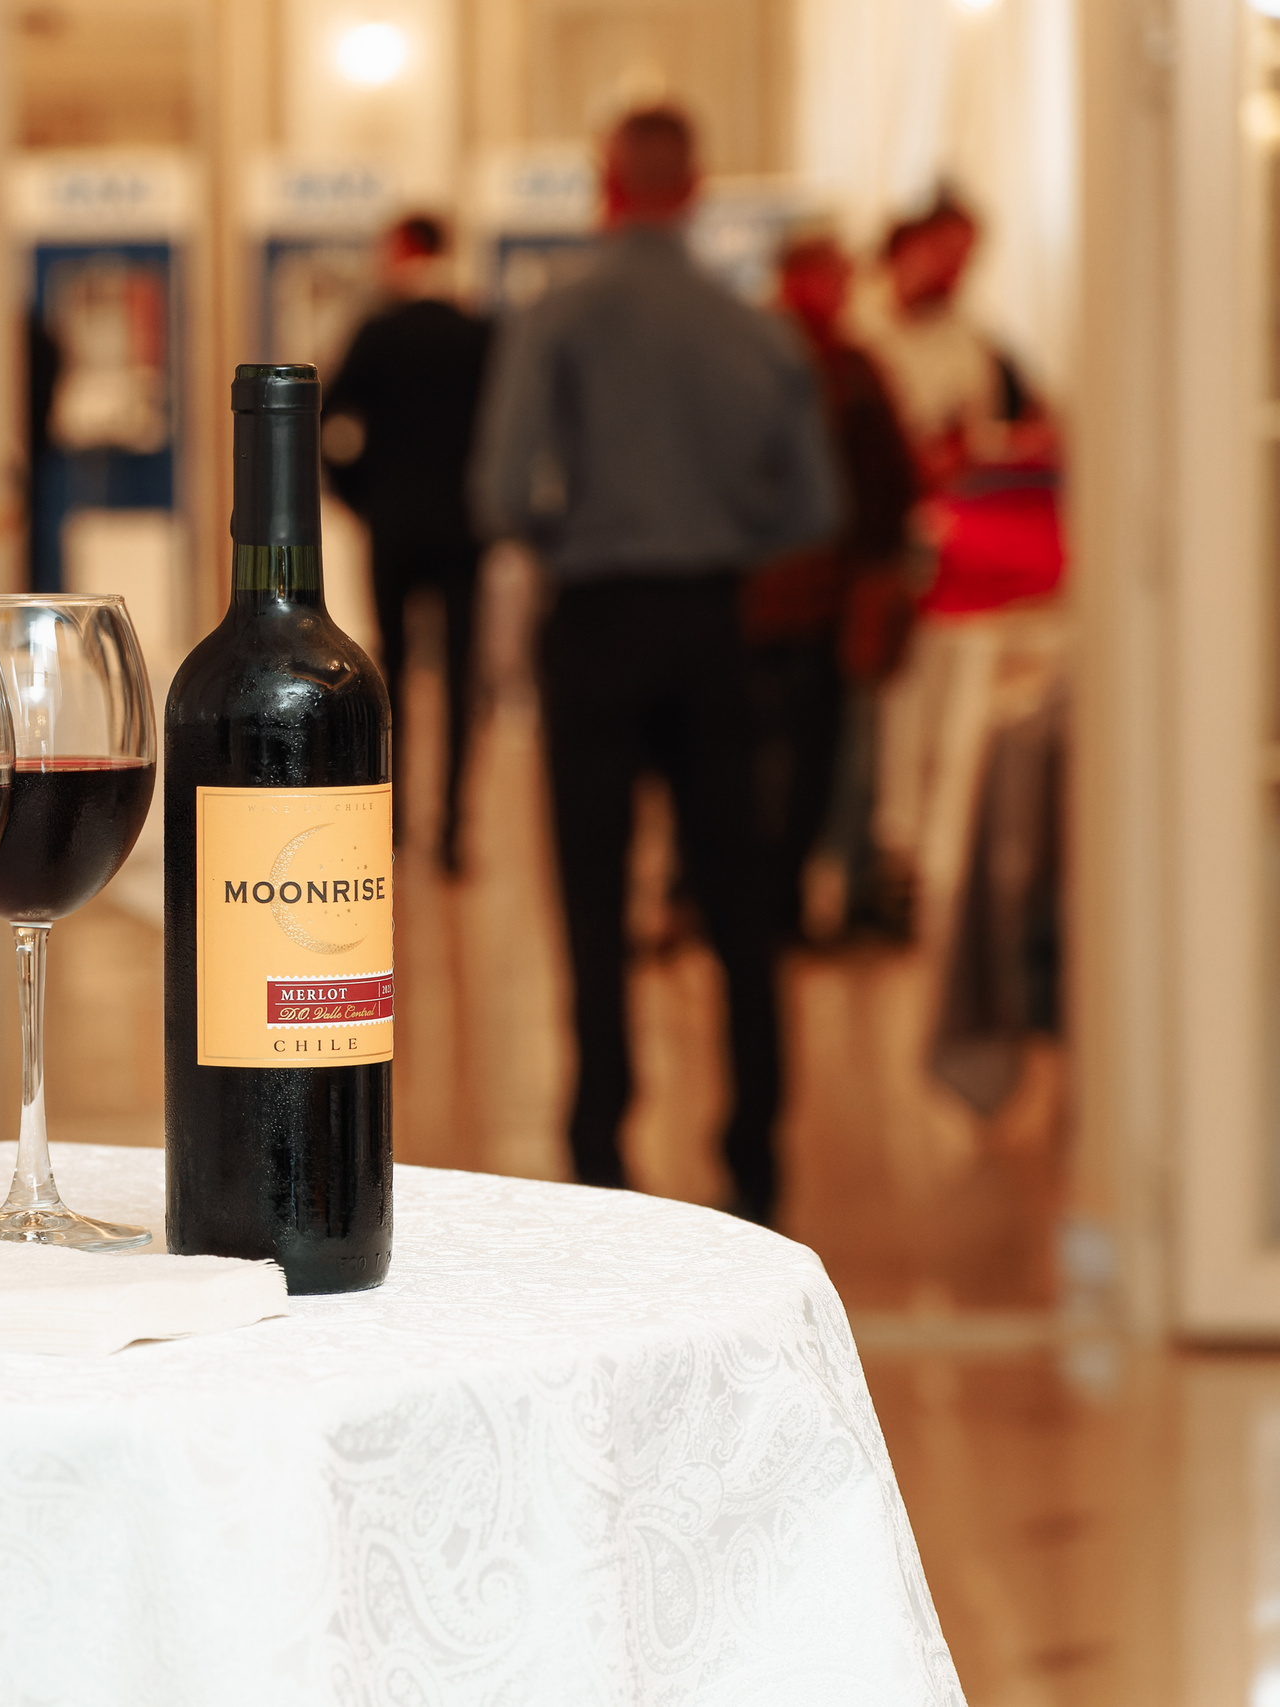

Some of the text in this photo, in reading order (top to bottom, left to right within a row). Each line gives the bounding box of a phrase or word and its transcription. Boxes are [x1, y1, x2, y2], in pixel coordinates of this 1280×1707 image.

[335, 802, 373, 811] CHILE
[224, 877, 385, 904] MOONRISE
[280, 988, 348, 1001] MERLOT
[278, 1003, 377, 1020] D.O. Valle Central
[273, 1038, 358, 1052] CHILE
